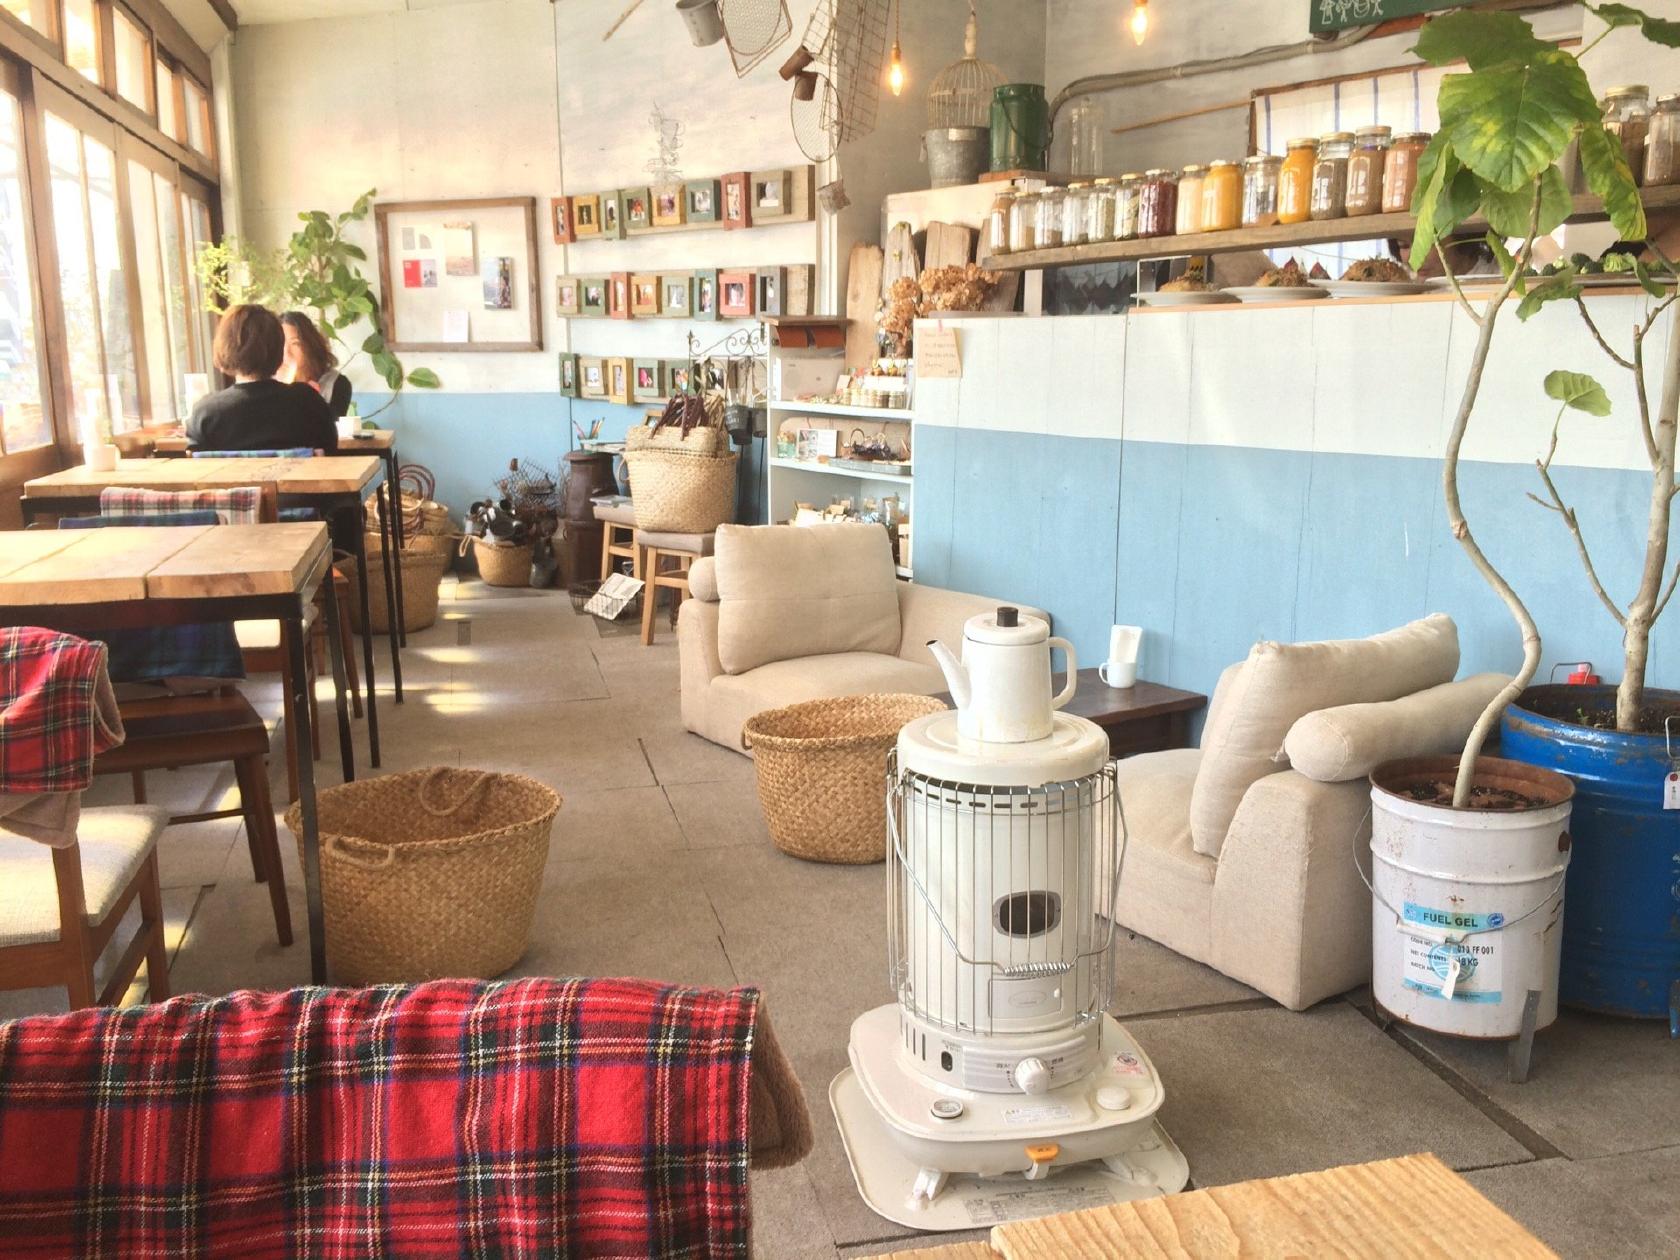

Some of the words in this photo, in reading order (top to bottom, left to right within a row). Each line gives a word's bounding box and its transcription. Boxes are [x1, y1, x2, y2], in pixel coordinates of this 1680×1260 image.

[1423, 912, 1452, 925] FUEL
[1454, 917, 1479, 928] GEL
[1472, 946, 1480, 954] FF
[1481, 946, 1494, 955] 001
